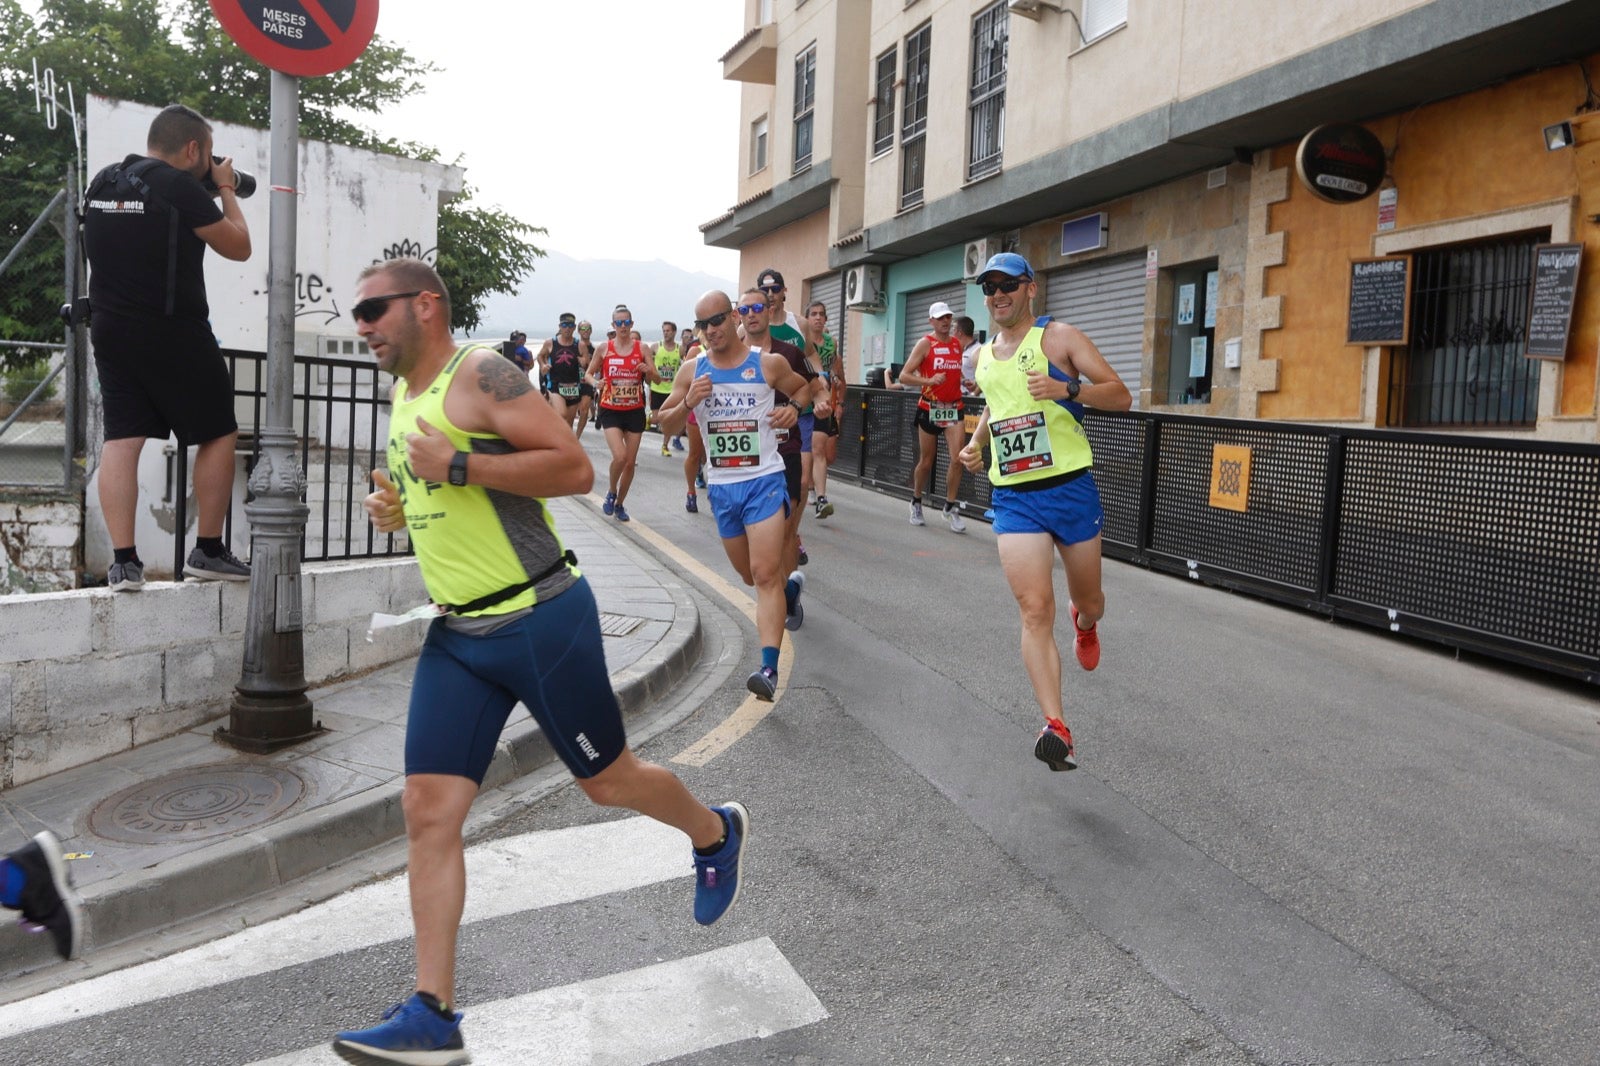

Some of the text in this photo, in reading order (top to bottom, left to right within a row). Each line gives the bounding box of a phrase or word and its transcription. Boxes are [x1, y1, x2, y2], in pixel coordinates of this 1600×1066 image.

[262, 7, 307, 27] MESES
[262, 21, 304, 39] PARES
[615, 387, 637, 395] 2140
[704, 397, 756, 407] CAXAR
[935, 409, 954, 420] 618
[716, 435, 751, 453] 936
[1001, 431, 1037, 457] 347
